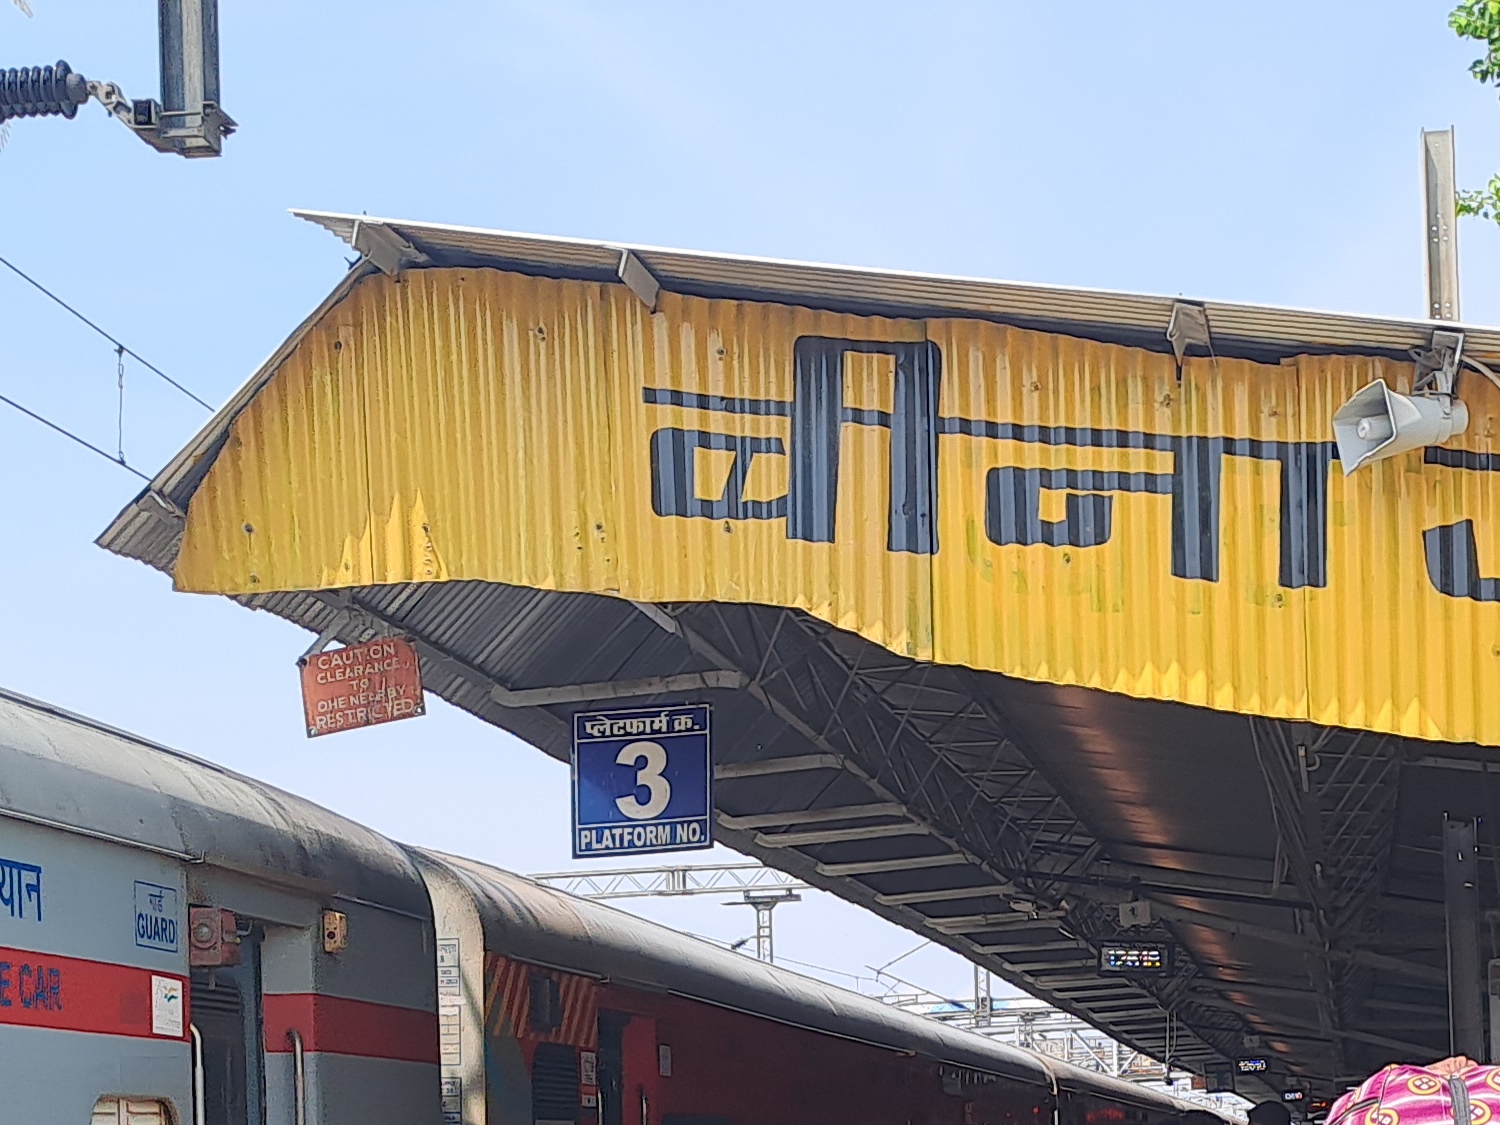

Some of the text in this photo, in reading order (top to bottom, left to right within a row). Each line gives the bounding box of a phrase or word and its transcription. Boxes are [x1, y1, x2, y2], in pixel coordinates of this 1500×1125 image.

[642, 335, 1340, 588] बीना
[317, 657, 400, 684] CLEARANCE
[315, 697, 415, 730] RESTRICTED
[317, 697, 347, 713] OHE
[584, 711, 670, 737] प्लेटफार्म
[614, 741, 671, 819] 3
[580, 821, 705, 850] PLATFORM NO.
[137, 912, 176, 944] GUARD
[19, 963, 63, 1011] CAR
